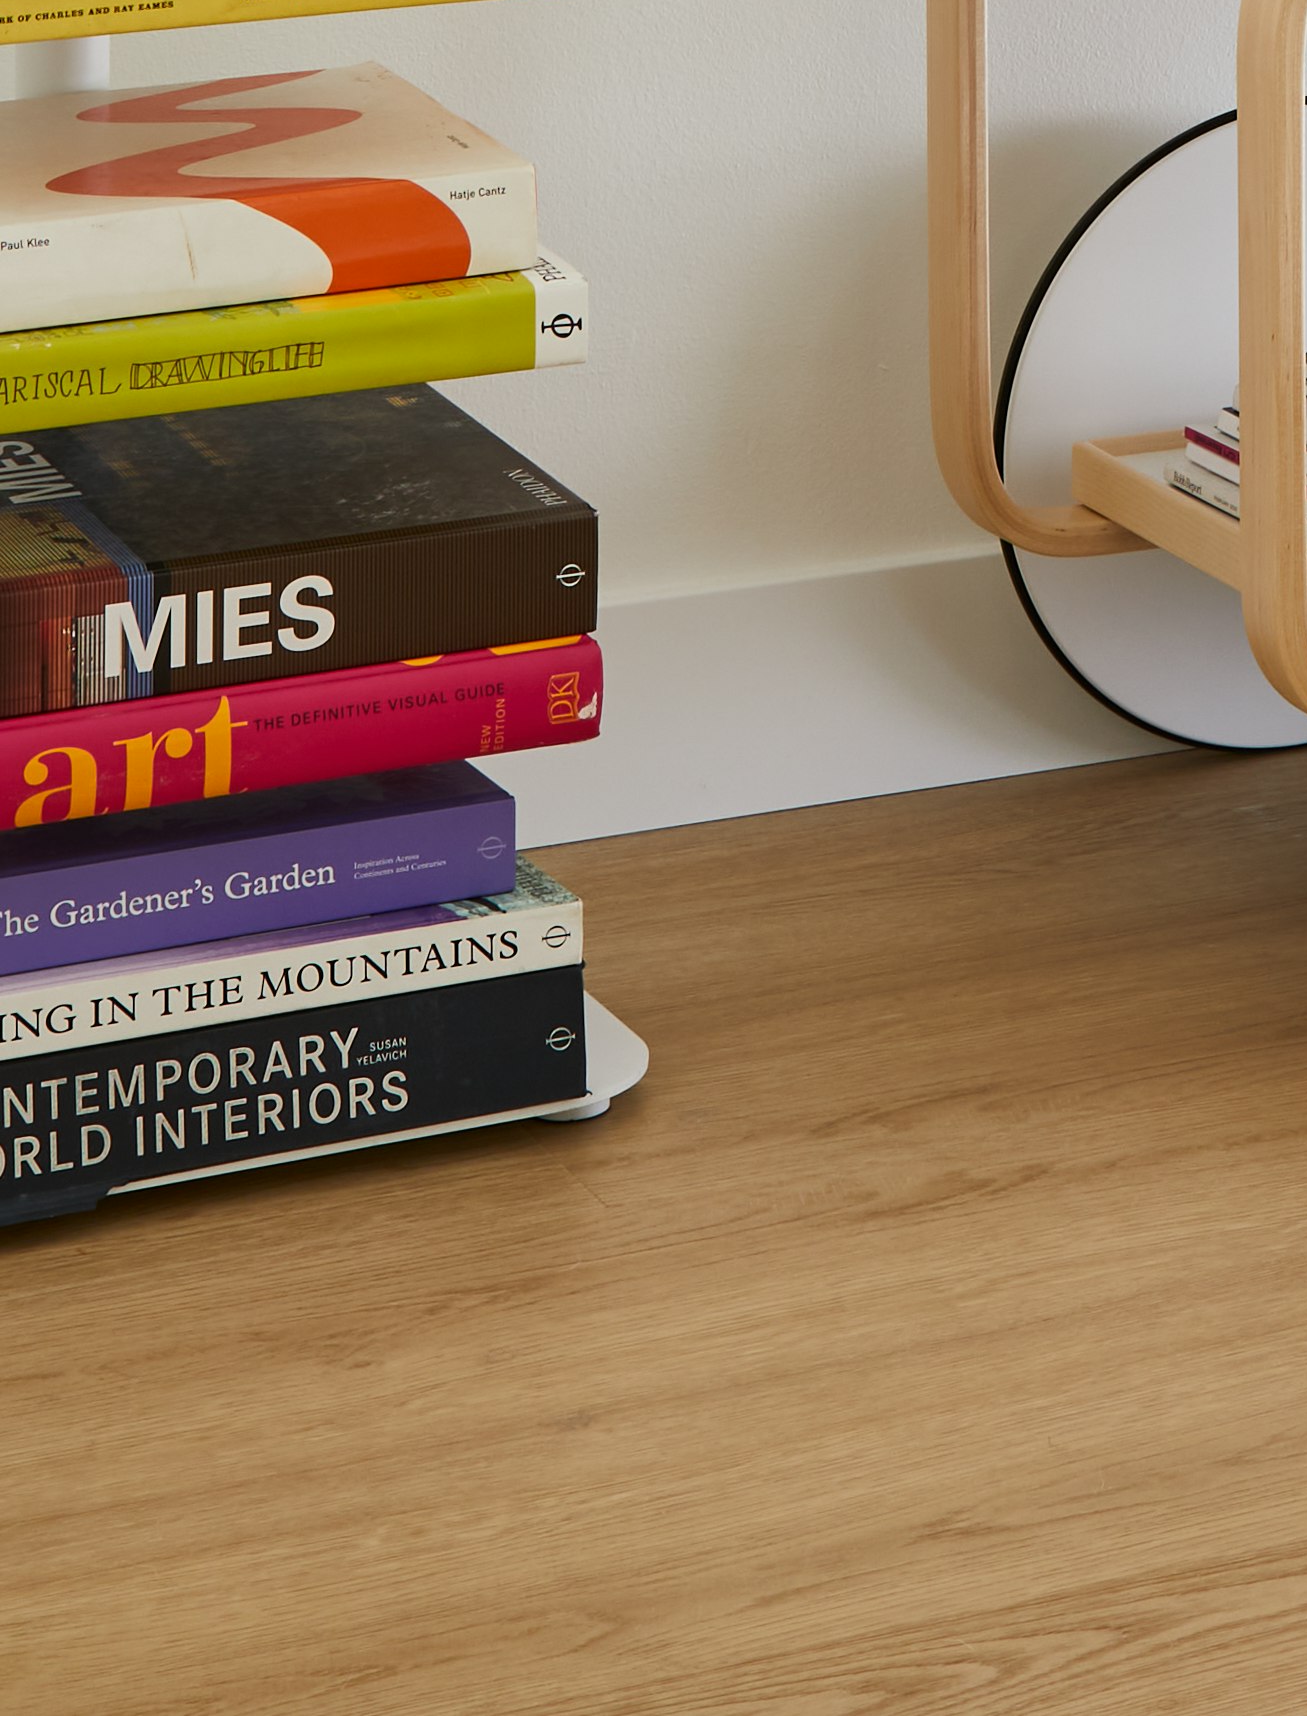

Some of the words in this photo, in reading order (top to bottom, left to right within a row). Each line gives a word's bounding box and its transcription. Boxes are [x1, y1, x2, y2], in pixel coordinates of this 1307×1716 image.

[17, 14, 31, 23] OF
[35, 7, 84, 21] CHARLES
[88, 5, 110, 17] AND
[114, 3, 134, 14] RAY
[138, 0, 174, 11] EAMES
[450, 189, 475, 201] Hatje
[478, 186, 507, 198] Cantz
[0, 239, 24, 251] Paul
[27, 237, 50, 248] Klee
[502, 468, 567, 506] PHAIDON
[103, 574, 336, 680] MIES
[550, 675, 575, 721] DK
[480, 725, 492, 753] NEW
[493, 698, 506, 751] EDITION
[13, 694, 249, 828] art
[253, 715, 285, 732] THE
[291, 700, 382, 728] DEFINITIVE
[387, 690, 448, 711] VISUAL
[454, 681, 505, 702] GUIDE
[353, 857, 394, 871] Inspiration
[353, 868, 394, 880] Continents
[396, 865, 410, 874] and
[411, 859, 447, 872] Centuries
[0, 910, 39, 937] he
[224, 863, 336, 901] Garden
[90, 992, 139, 1028] IN
[152, 975, 243, 1017] THE
[257, 930, 519, 1001] MOUNTAINS
[356, 1048, 407, 1067] YELAVICH
[369, 1036, 407, 1052] SUSAN
[0, 1124, 112, 1180] RLD
[136, 1070, 409, 1157] INTERIORS
